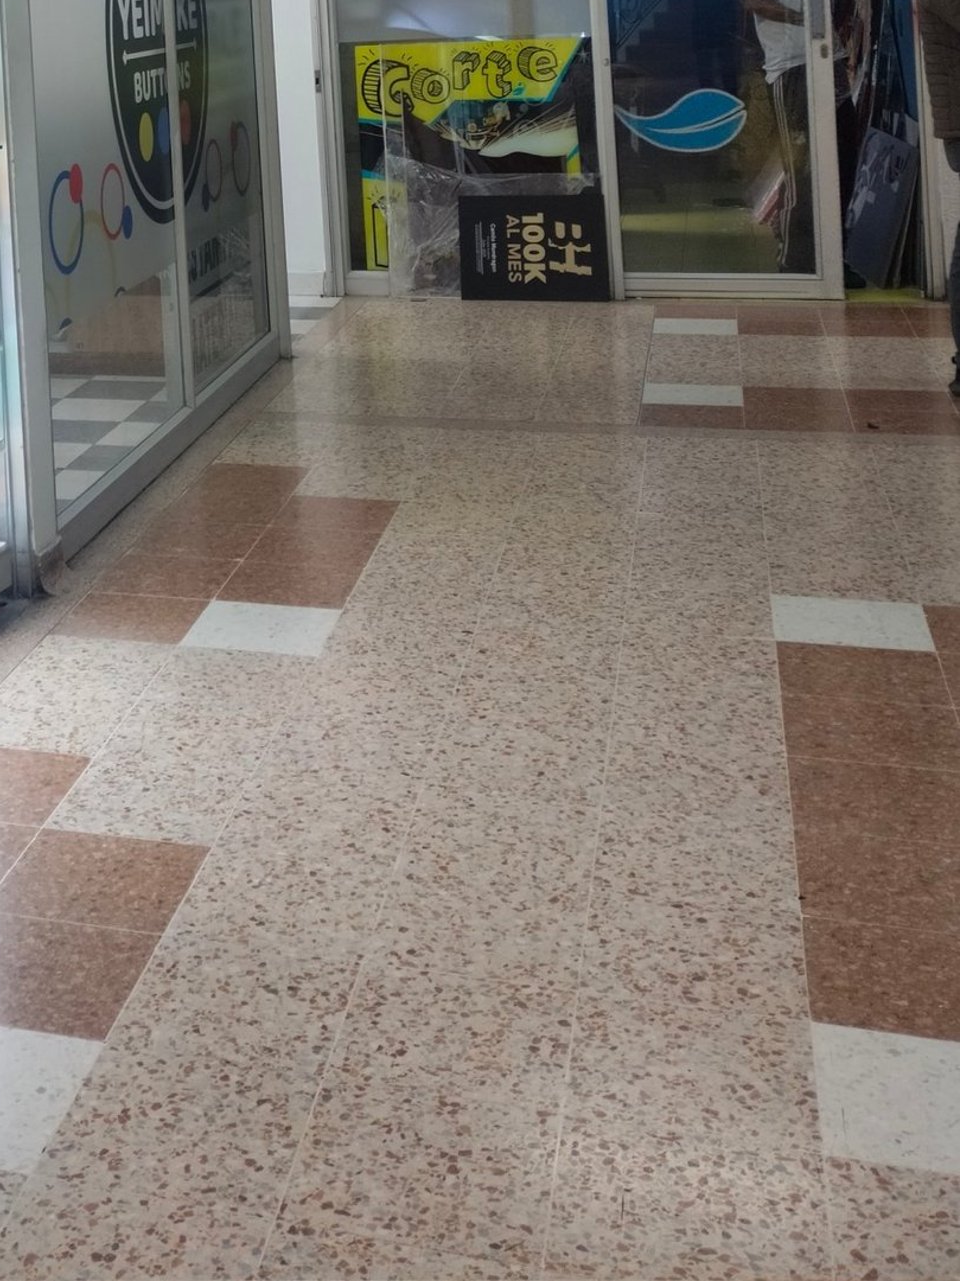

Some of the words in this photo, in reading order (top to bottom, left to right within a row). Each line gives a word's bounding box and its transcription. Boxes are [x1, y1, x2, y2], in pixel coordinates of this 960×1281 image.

[361, 46, 559, 118] Corte
[506, 215, 520, 239] AL
[522, 212, 547, 284] 100K
[507, 243, 522, 283] MES
